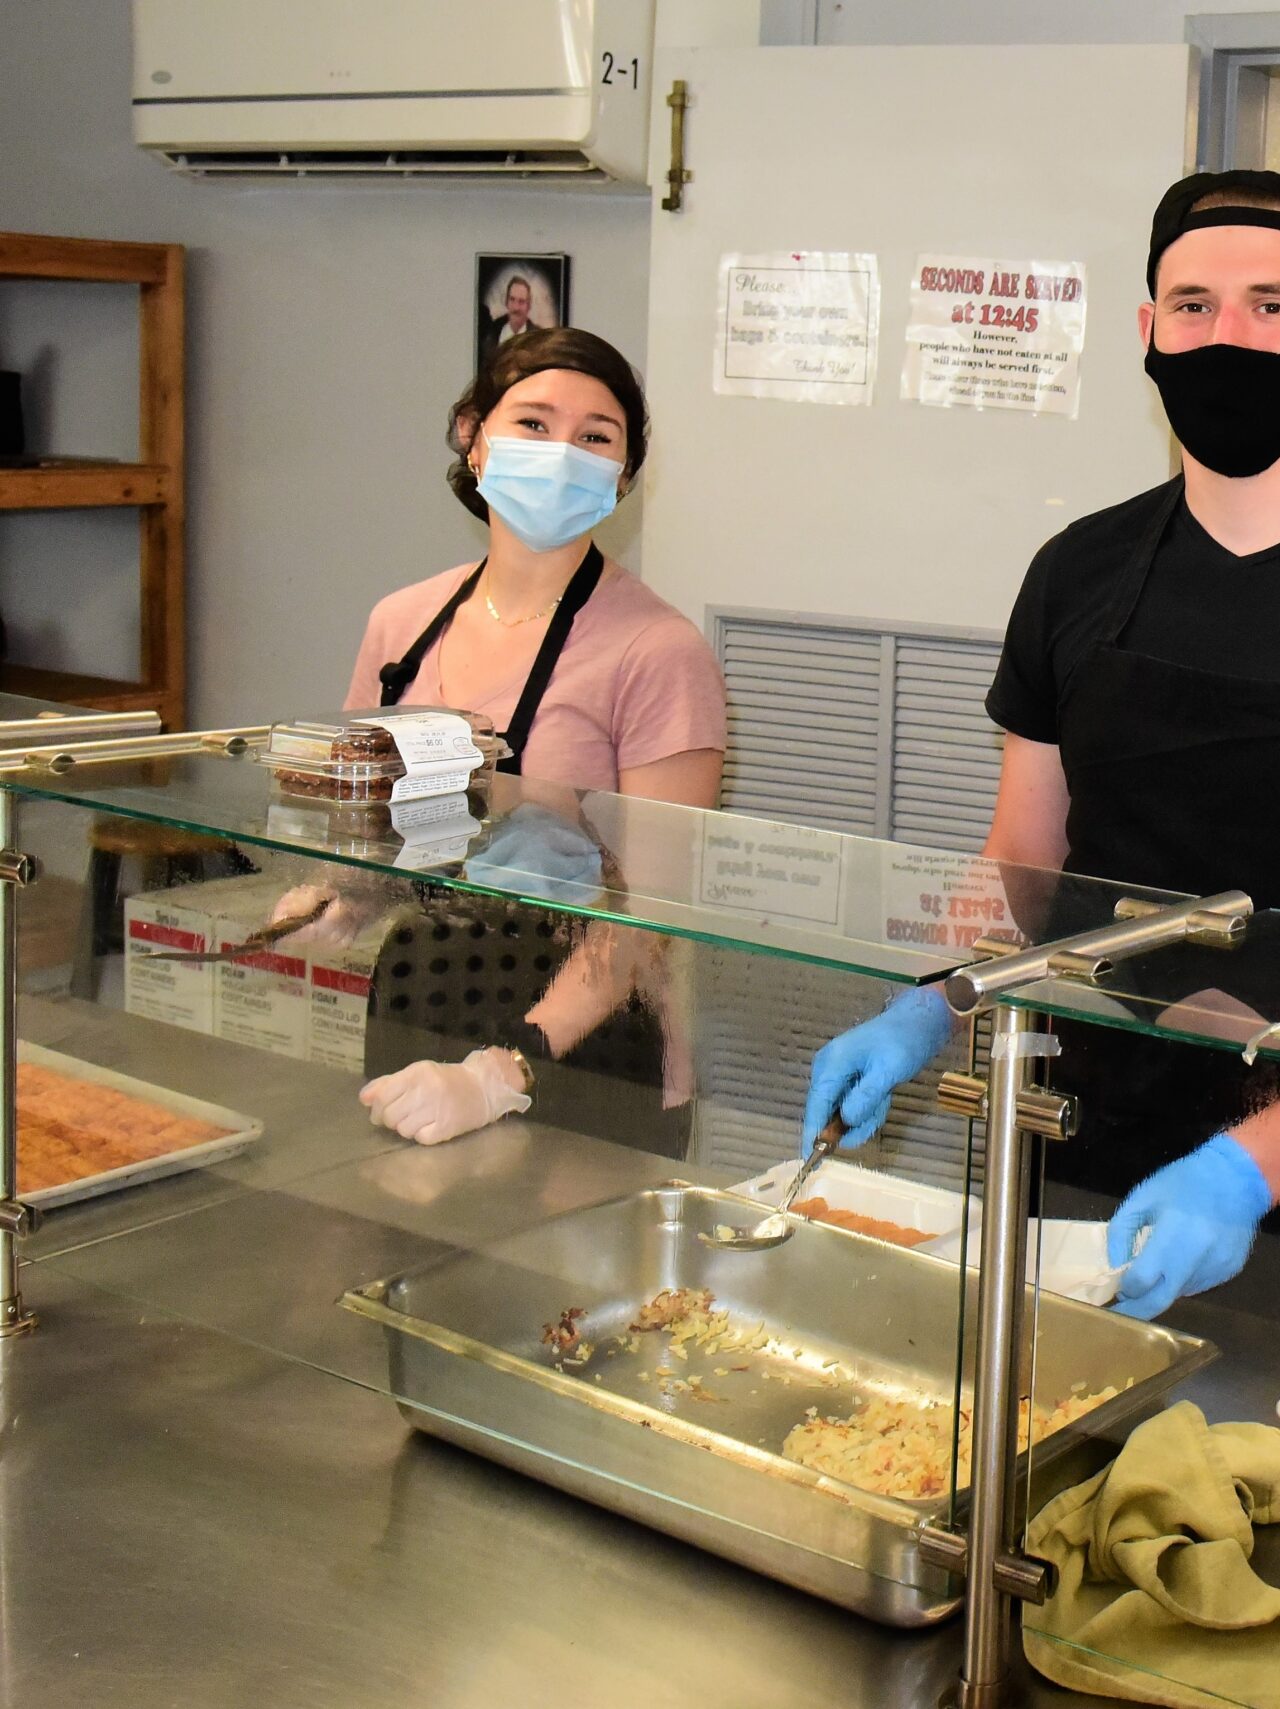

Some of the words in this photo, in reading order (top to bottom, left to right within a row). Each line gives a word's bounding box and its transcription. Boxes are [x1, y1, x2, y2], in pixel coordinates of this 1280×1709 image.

[602, 51, 638, 90] 2-1
[920, 266, 985, 295] SECONDS
[988, 272, 1020, 298] ARE
[1025, 274, 1082, 303] SERVED
[951, 301, 975, 324] at
[978, 303, 1039, 333] 12:45
[973, 330, 1018, 344] However,
[919, 342, 950, 353] people
[951, 343, 971, 353] who
[972, 344, 995, 356] have
[997, 349, 1013, 357] not
[1015, 350, 1042, 359] eaten
[1055, 352, 1068, 362] all
[932, 355, 950, 365] will
[951, 357, 983, 370] always
[985, 360, 997, 369] be
[998, 363, 1029, 373] served
